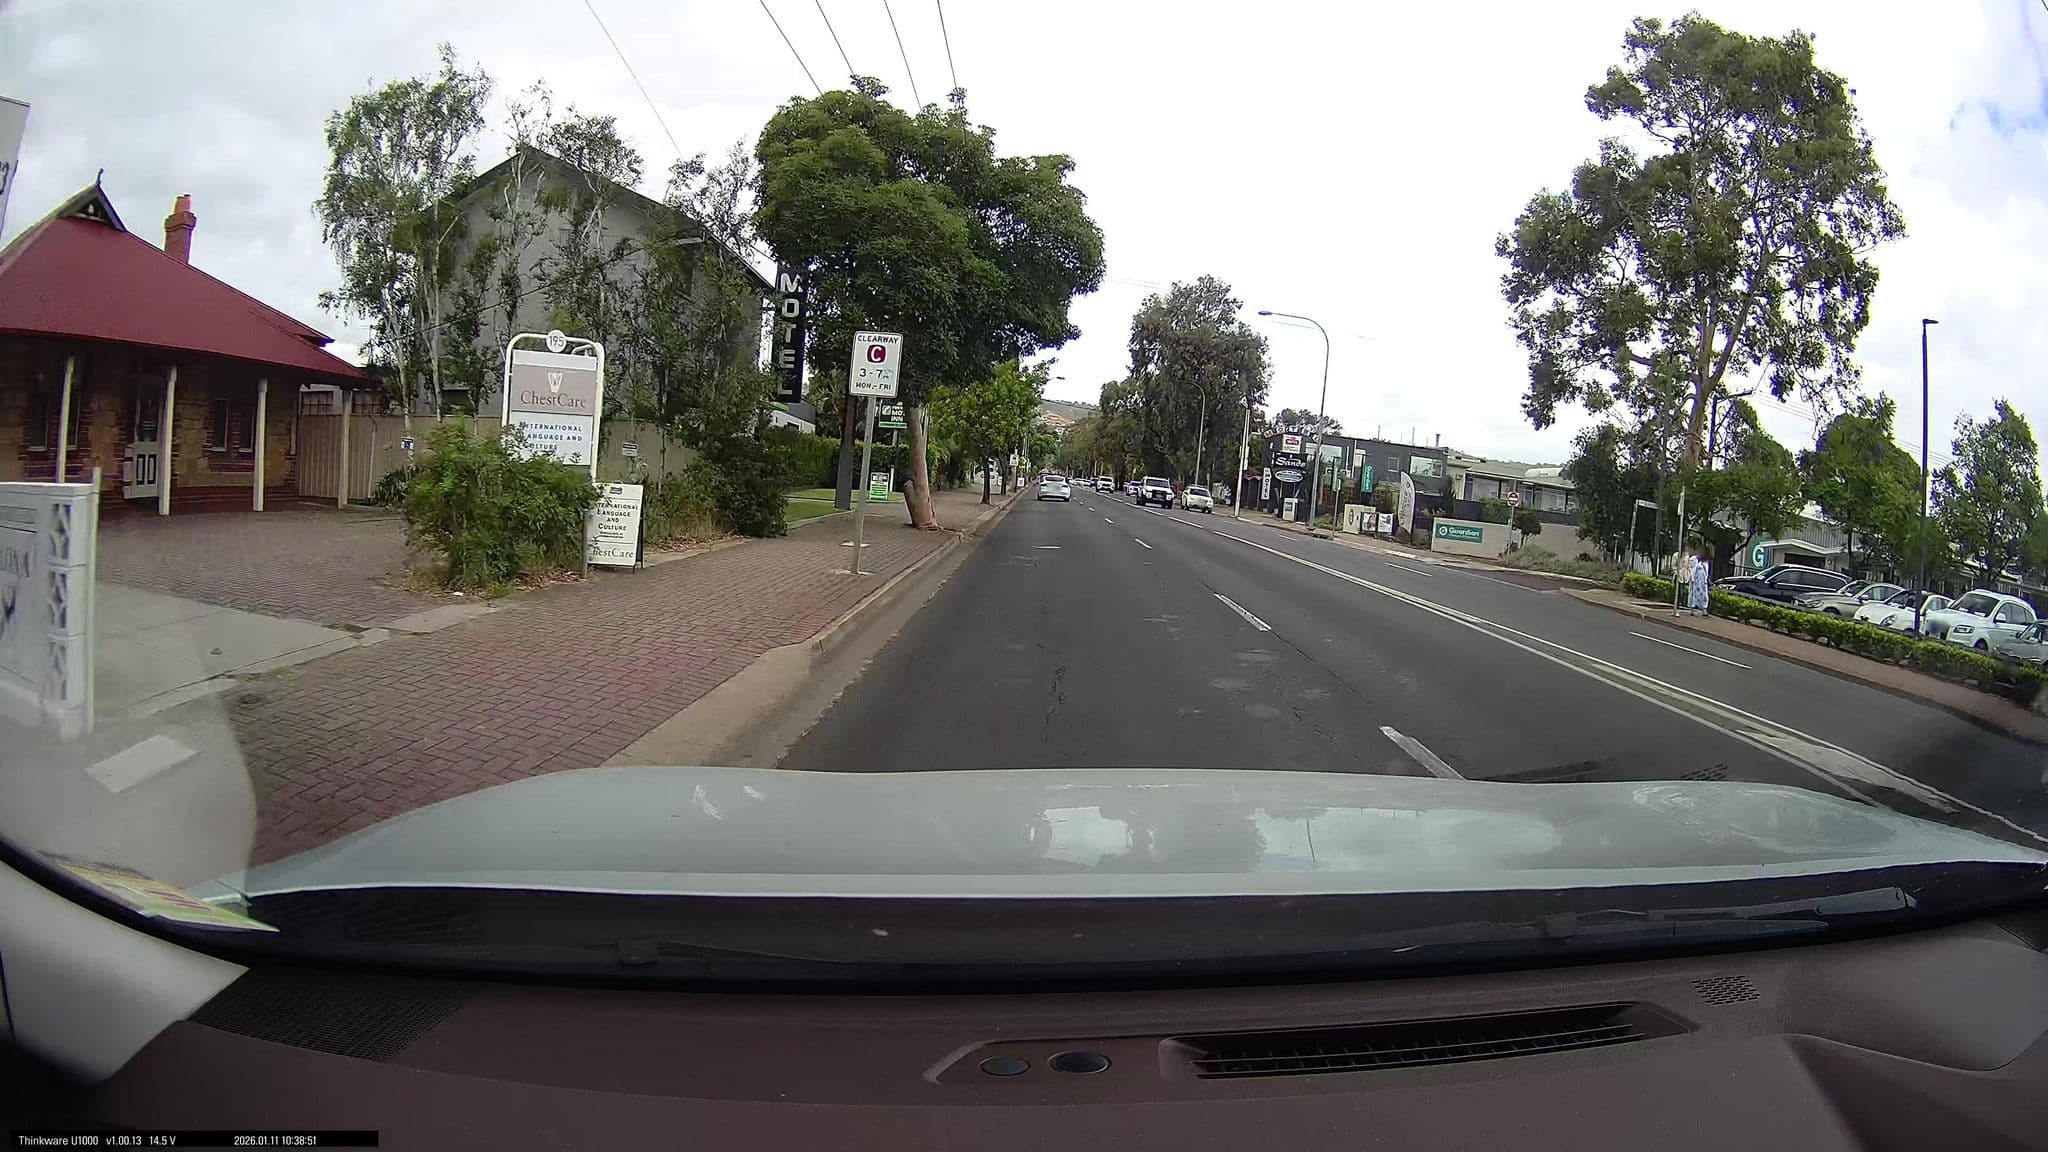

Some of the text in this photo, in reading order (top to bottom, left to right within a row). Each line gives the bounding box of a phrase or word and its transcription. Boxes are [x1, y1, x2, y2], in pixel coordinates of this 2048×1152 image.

[777, 273, 803, 395] MOTEL
[857, 334, 899, 344] CLEARWAY
[550, 335, 564, 347] 195
[871, 346, 882, 361] C
[520, 390, 588, 408] ChestCare
[520, 422, 582, 432] NTERNATIONAL
[598, 523, 627, 531] CULTURE
[1449, 526, 1480, 537] Guardian
[593, 548, 634, 558] hestCare
